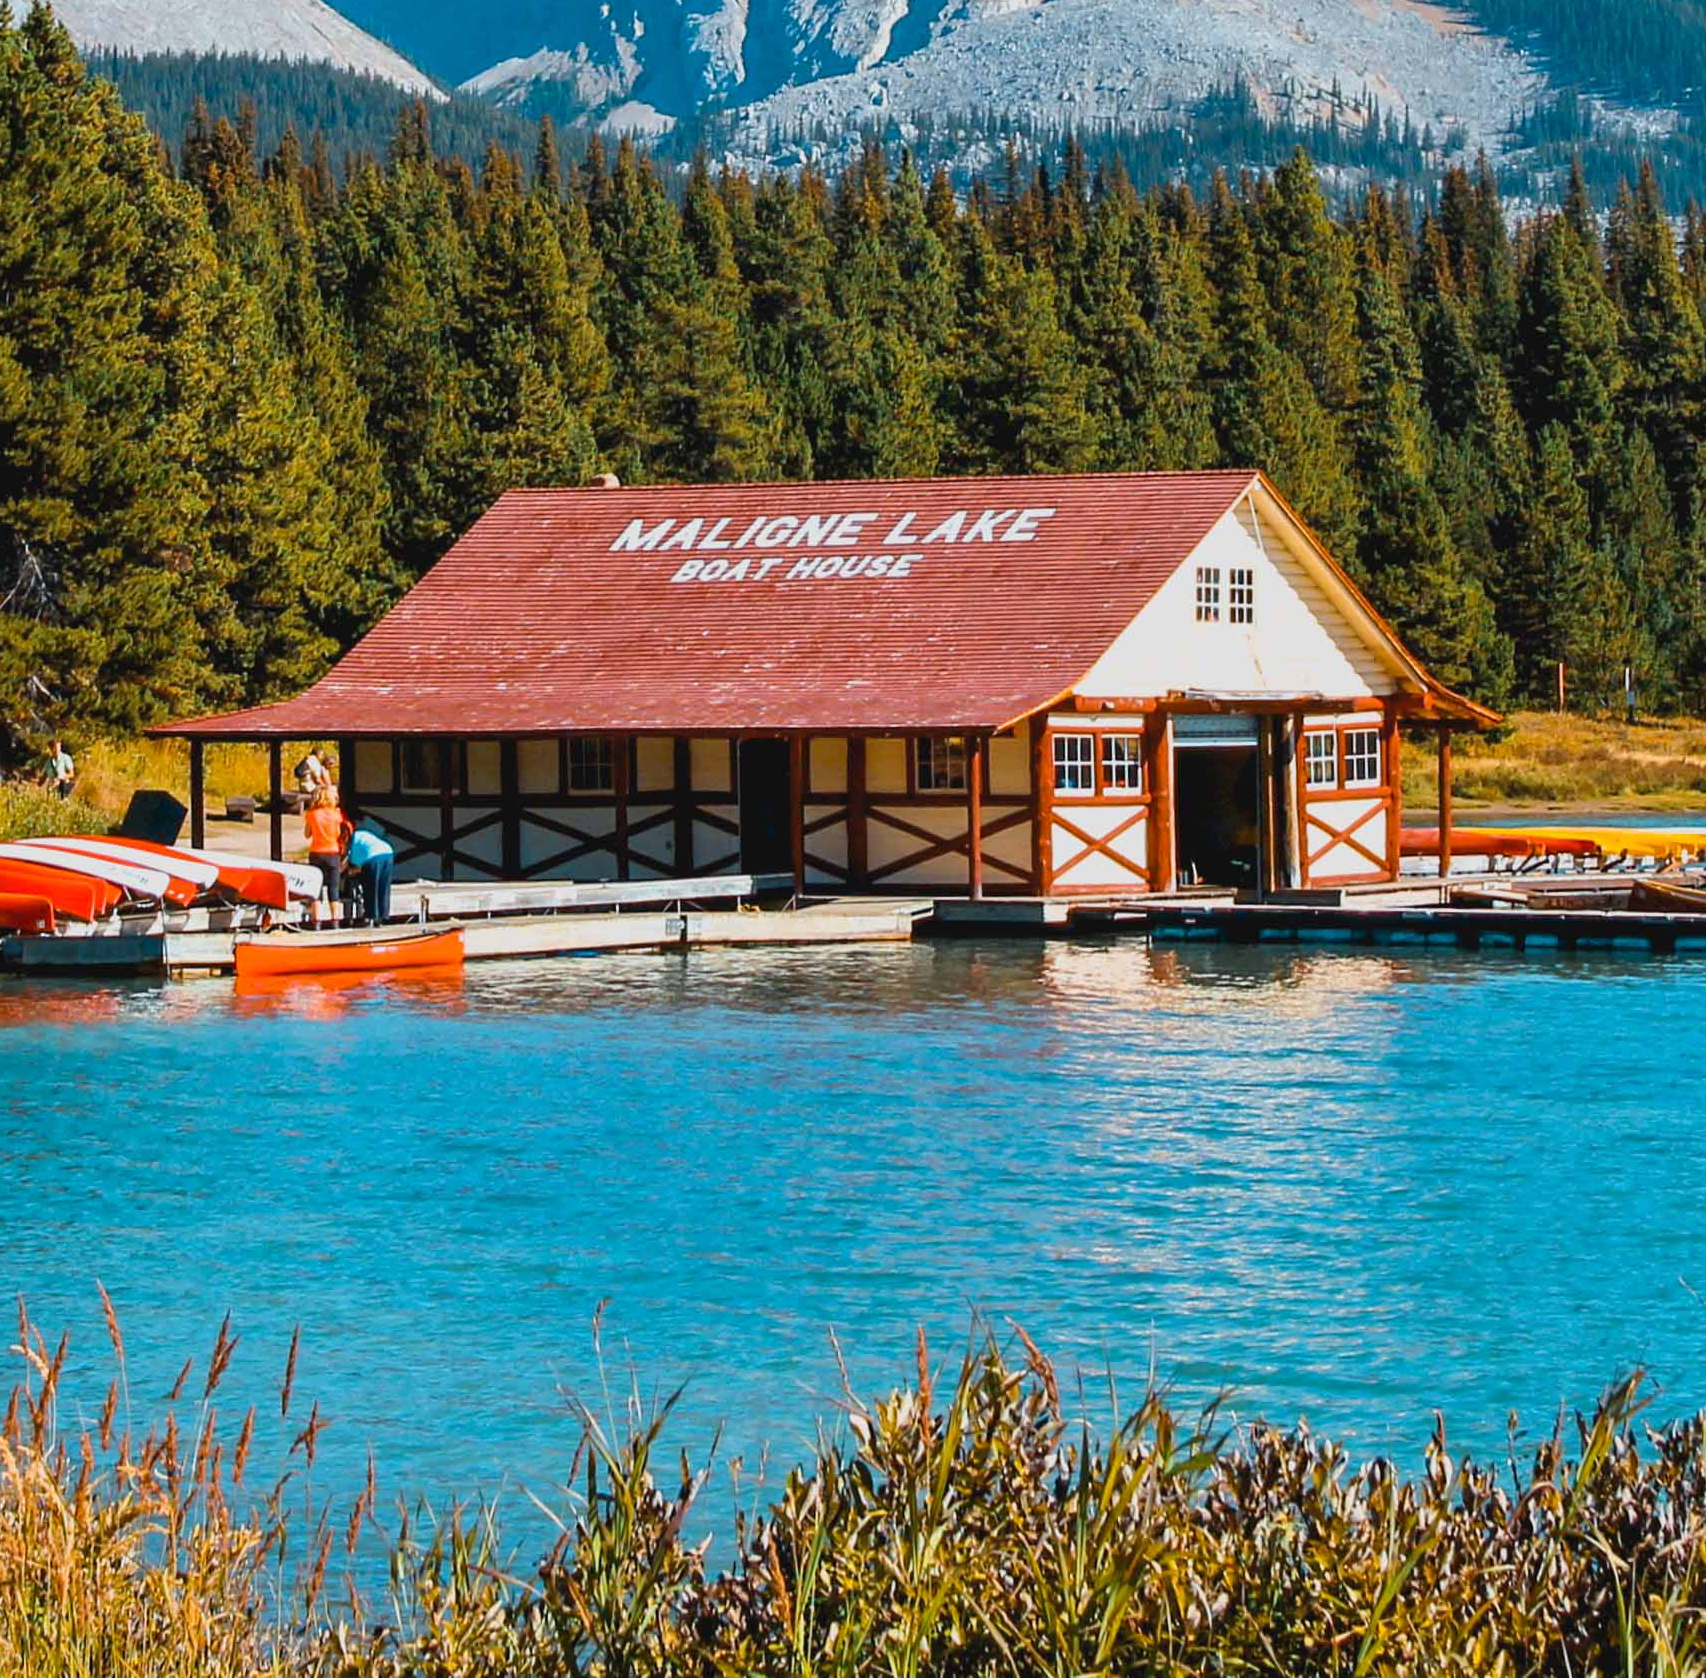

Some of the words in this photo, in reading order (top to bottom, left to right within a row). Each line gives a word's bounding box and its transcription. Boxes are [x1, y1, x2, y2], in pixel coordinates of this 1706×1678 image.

[608, 512, 879, 552] MALIGNE
[881, 507, 1057, 545] LAKE
[669, 557, 784, 582] BOAT
[785, 554, 925, 579] HOUSE
